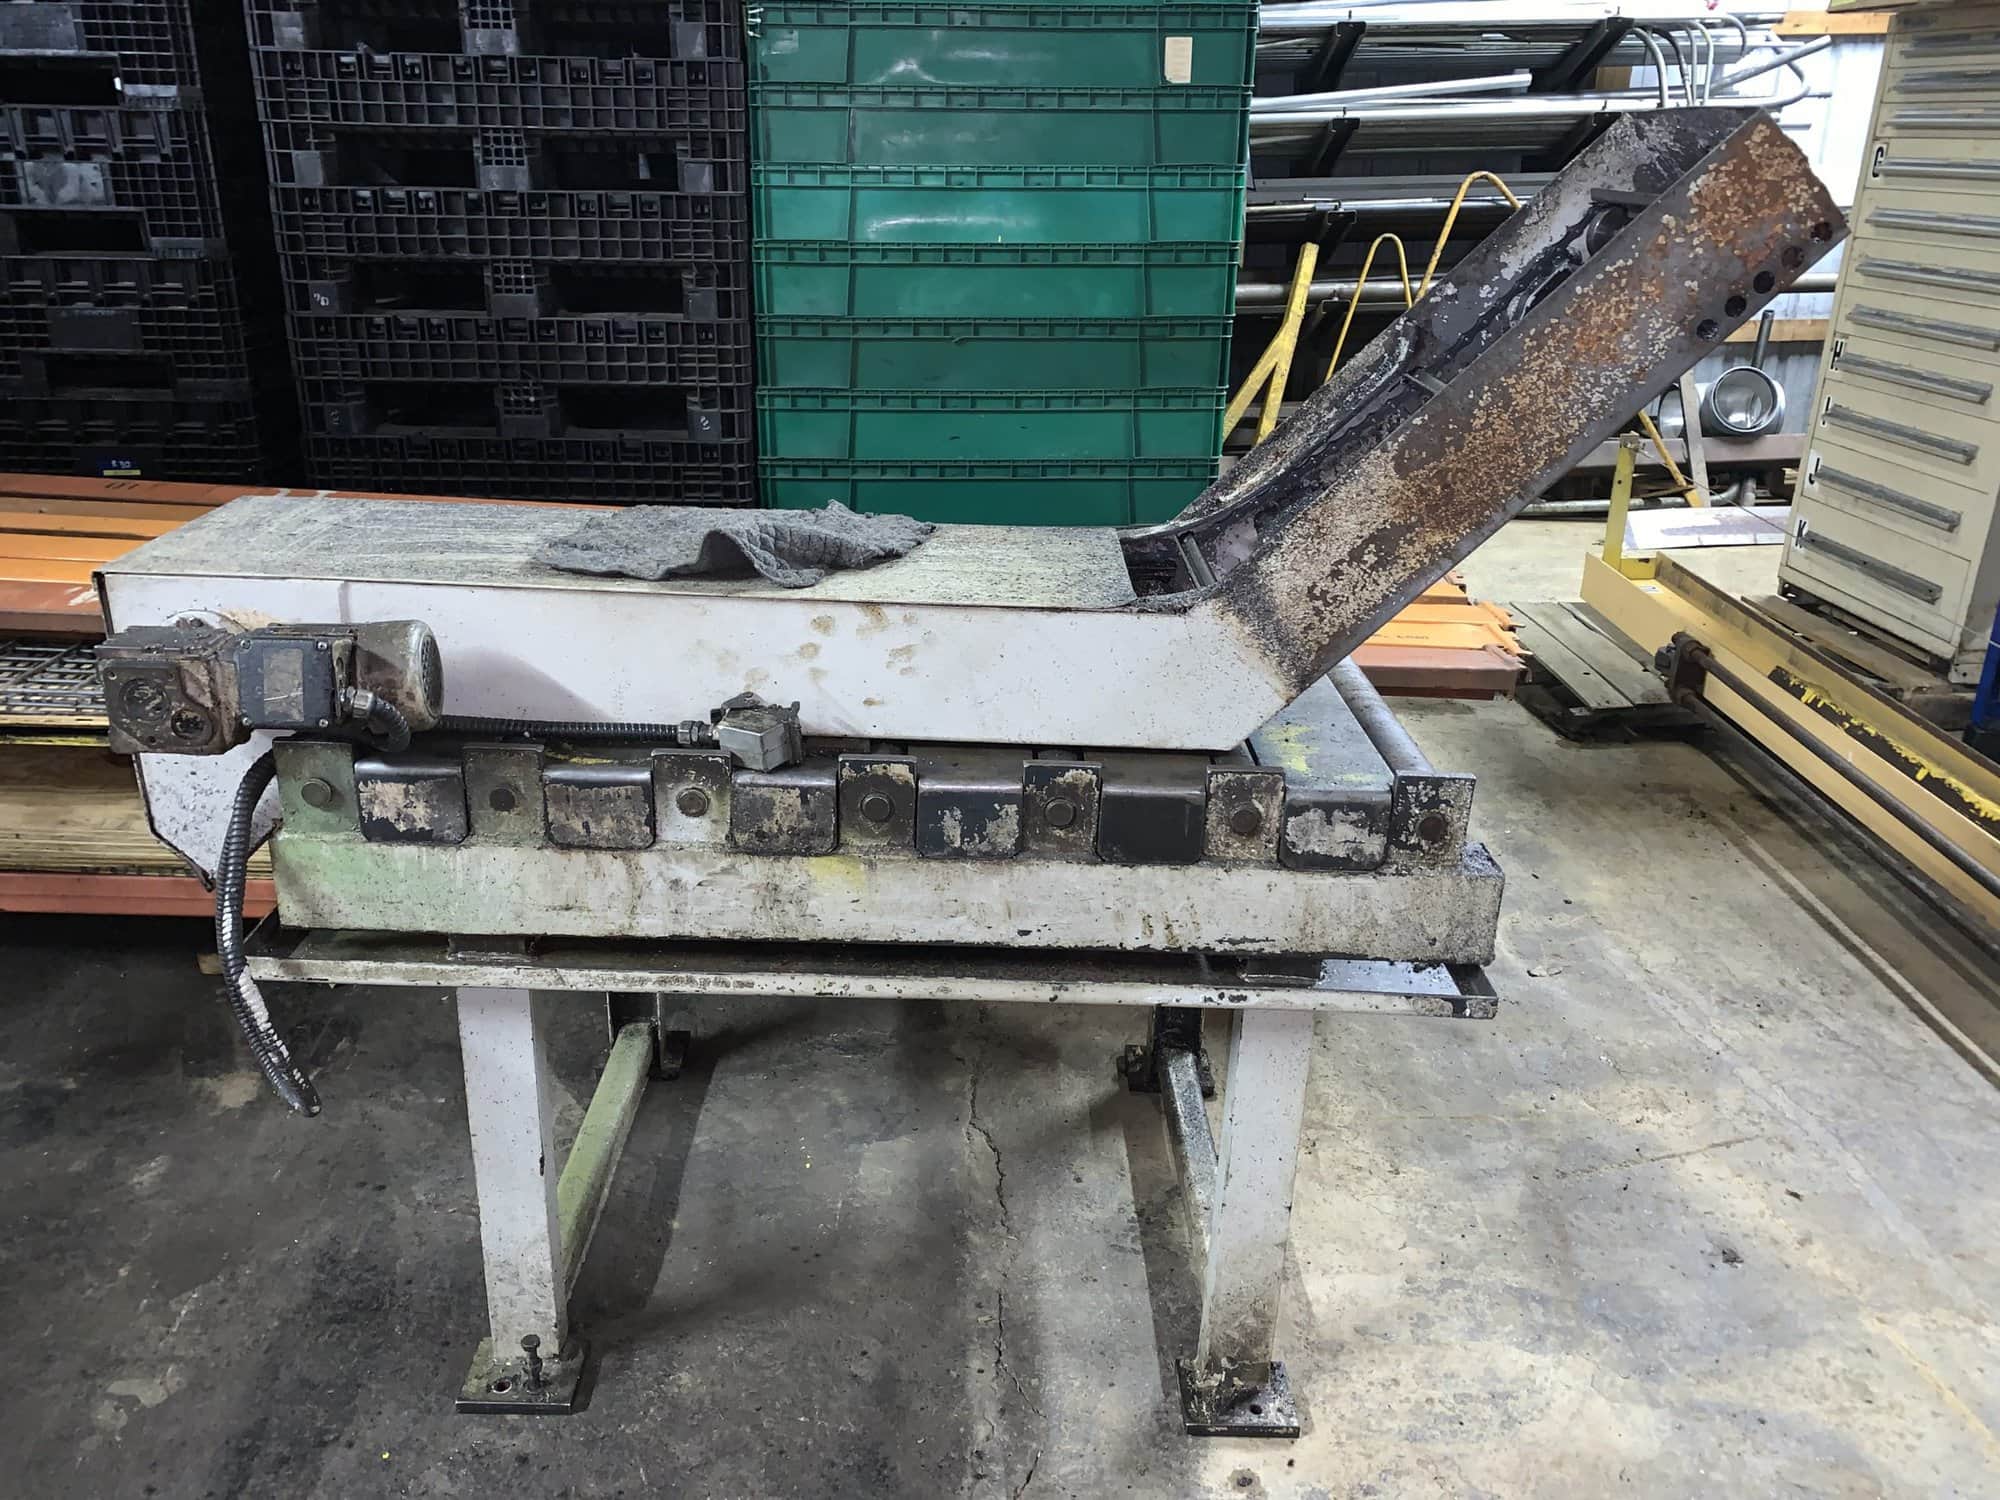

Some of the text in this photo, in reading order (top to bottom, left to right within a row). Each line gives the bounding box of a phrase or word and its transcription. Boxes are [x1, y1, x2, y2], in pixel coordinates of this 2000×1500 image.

[1830, 340, 1844, 371] H
[1809, 457, 1820, 485] J
[1795, 519, 1807, 548] K
